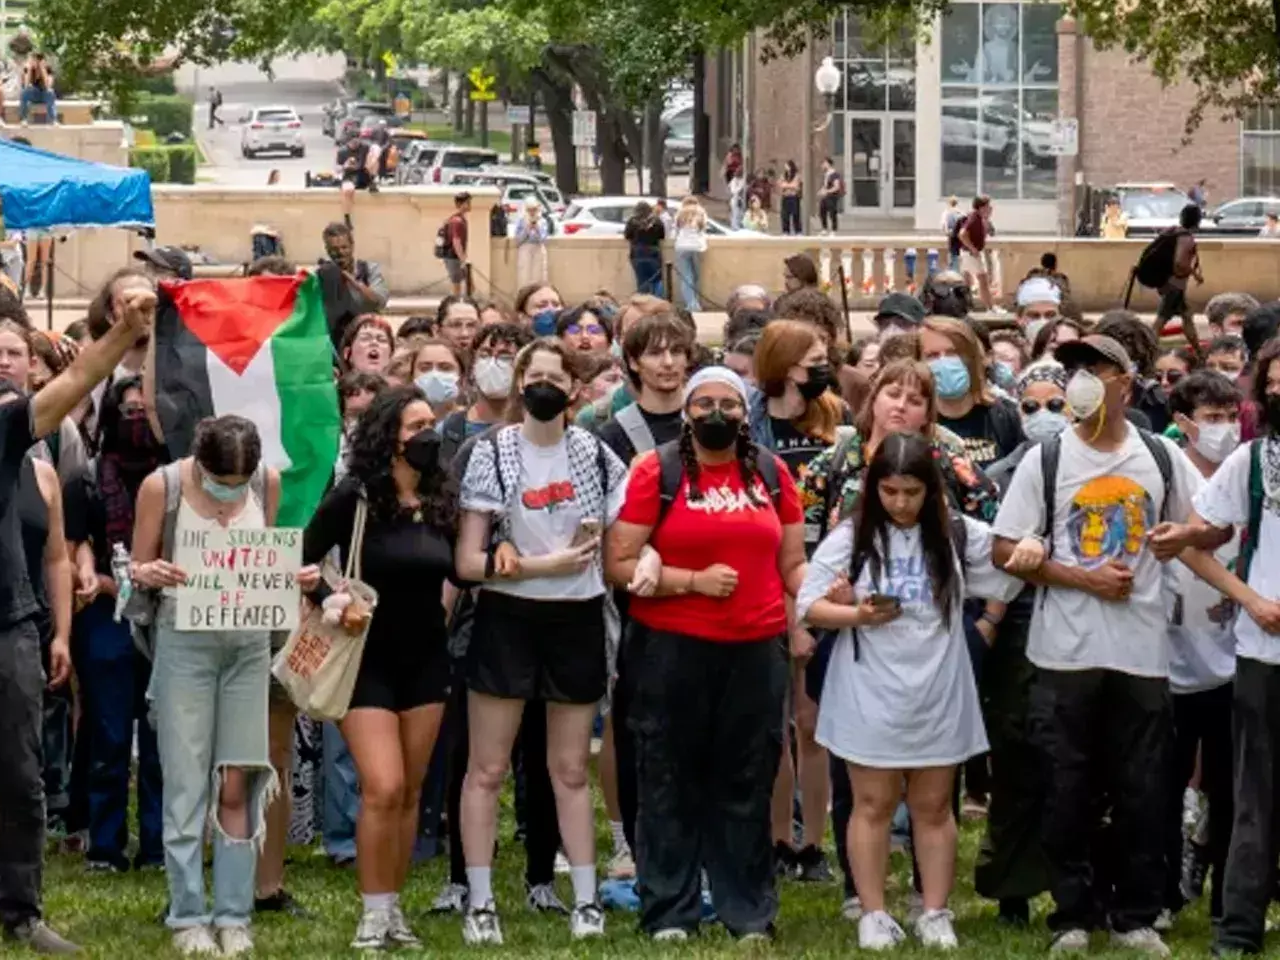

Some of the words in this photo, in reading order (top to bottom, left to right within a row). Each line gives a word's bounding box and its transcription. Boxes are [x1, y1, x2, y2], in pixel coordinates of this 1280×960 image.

[182, 529, 211, 549] THE
[226, 528, 299, 548] STUDENTS
[201, 546, 277, 571] UNITED
[182, 573, 224, 590] WILL
[237, 572, 295, 591] NEVER
[219, 590, 246, 606] BE
[189, 605, 287, 628] DEFEATED
